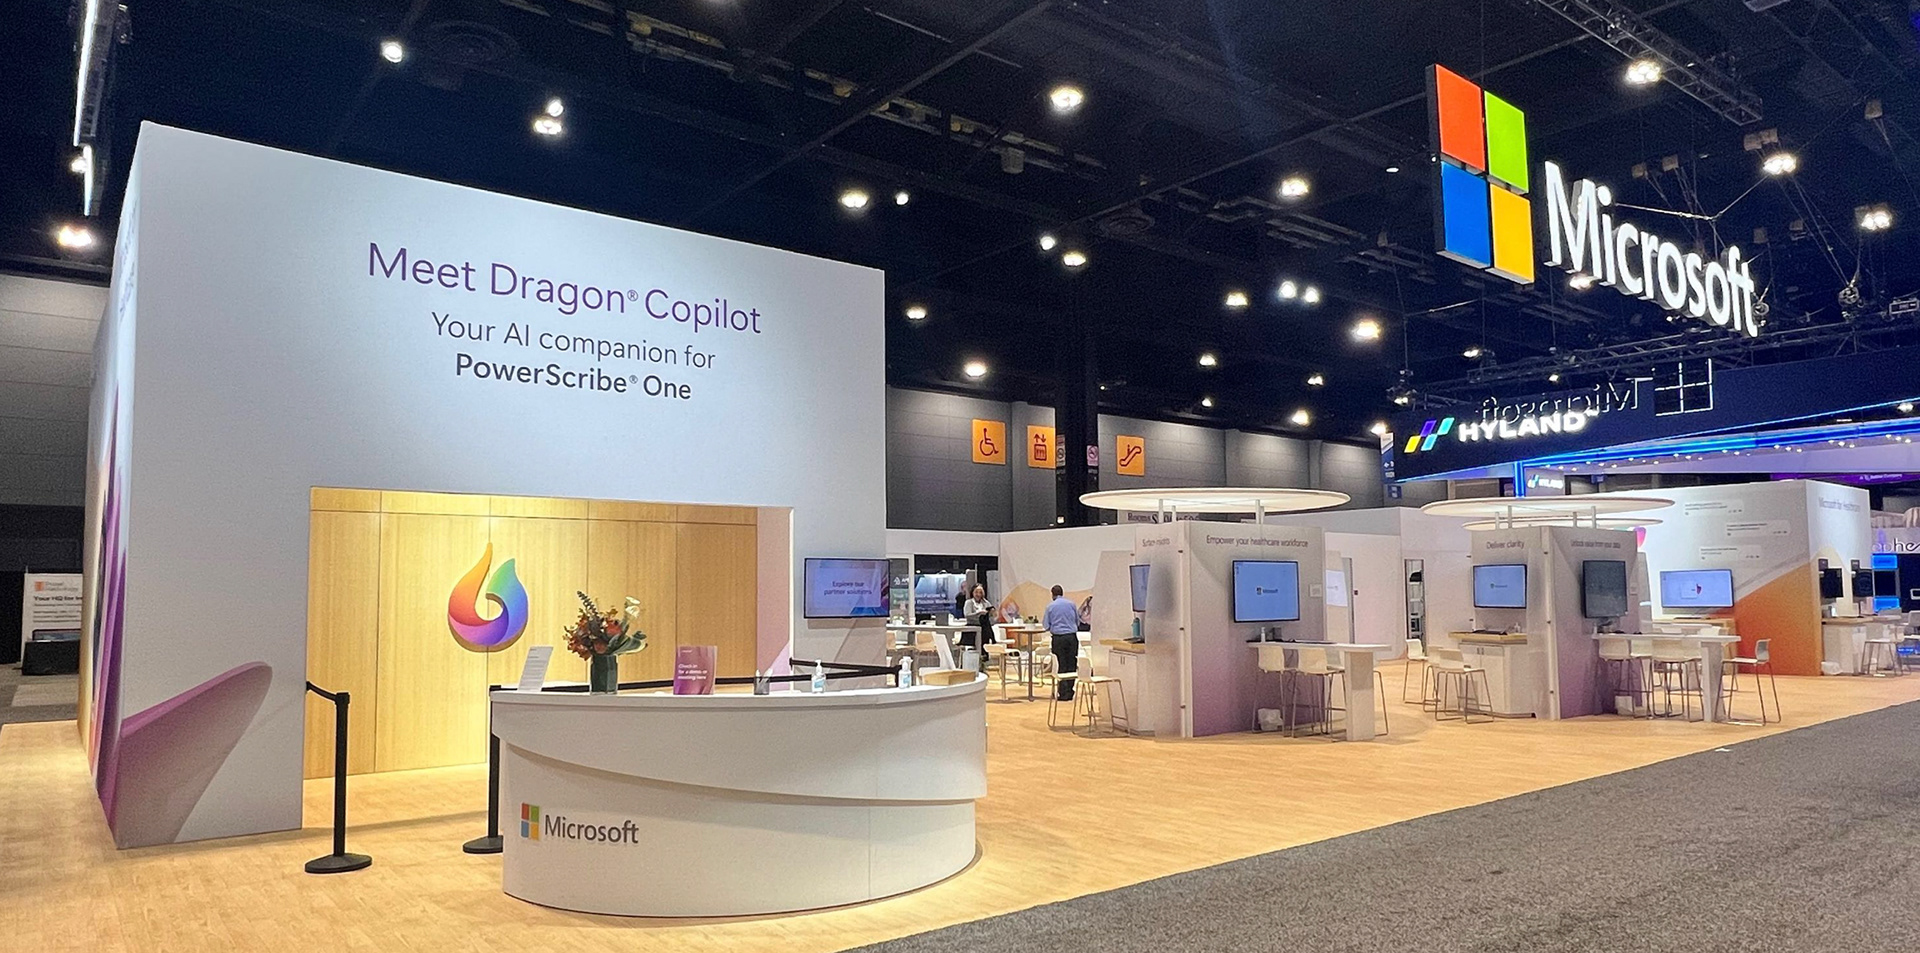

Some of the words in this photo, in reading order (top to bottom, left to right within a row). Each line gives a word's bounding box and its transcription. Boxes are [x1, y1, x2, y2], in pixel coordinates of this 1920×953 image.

[1544, 160, 1759, 338] Microsoft
[367, 242, 477, 293] Meet
[644, 288, 762, 335] Copilot
[430, 311, 497, 343] Your
[503, 322, 531, 348] AI
[538, 332, 678, 366] companion
[684, 345, 717, 370] for
[642, 374, 692, 400] One
[1127, 512, 1151, 521] Rooms
[1206, 535, 1234, 546] Empower
[1236, 538, 1249, 547] your
[1250, 537, 1280, 546] healthcare
[1281, 538, 1309, 548] workforce
[1486, 541, 1506, 549] Deliver
[1507, 541, 1525, 549] clarity
[544, 814, 640, 844] Microsoft
